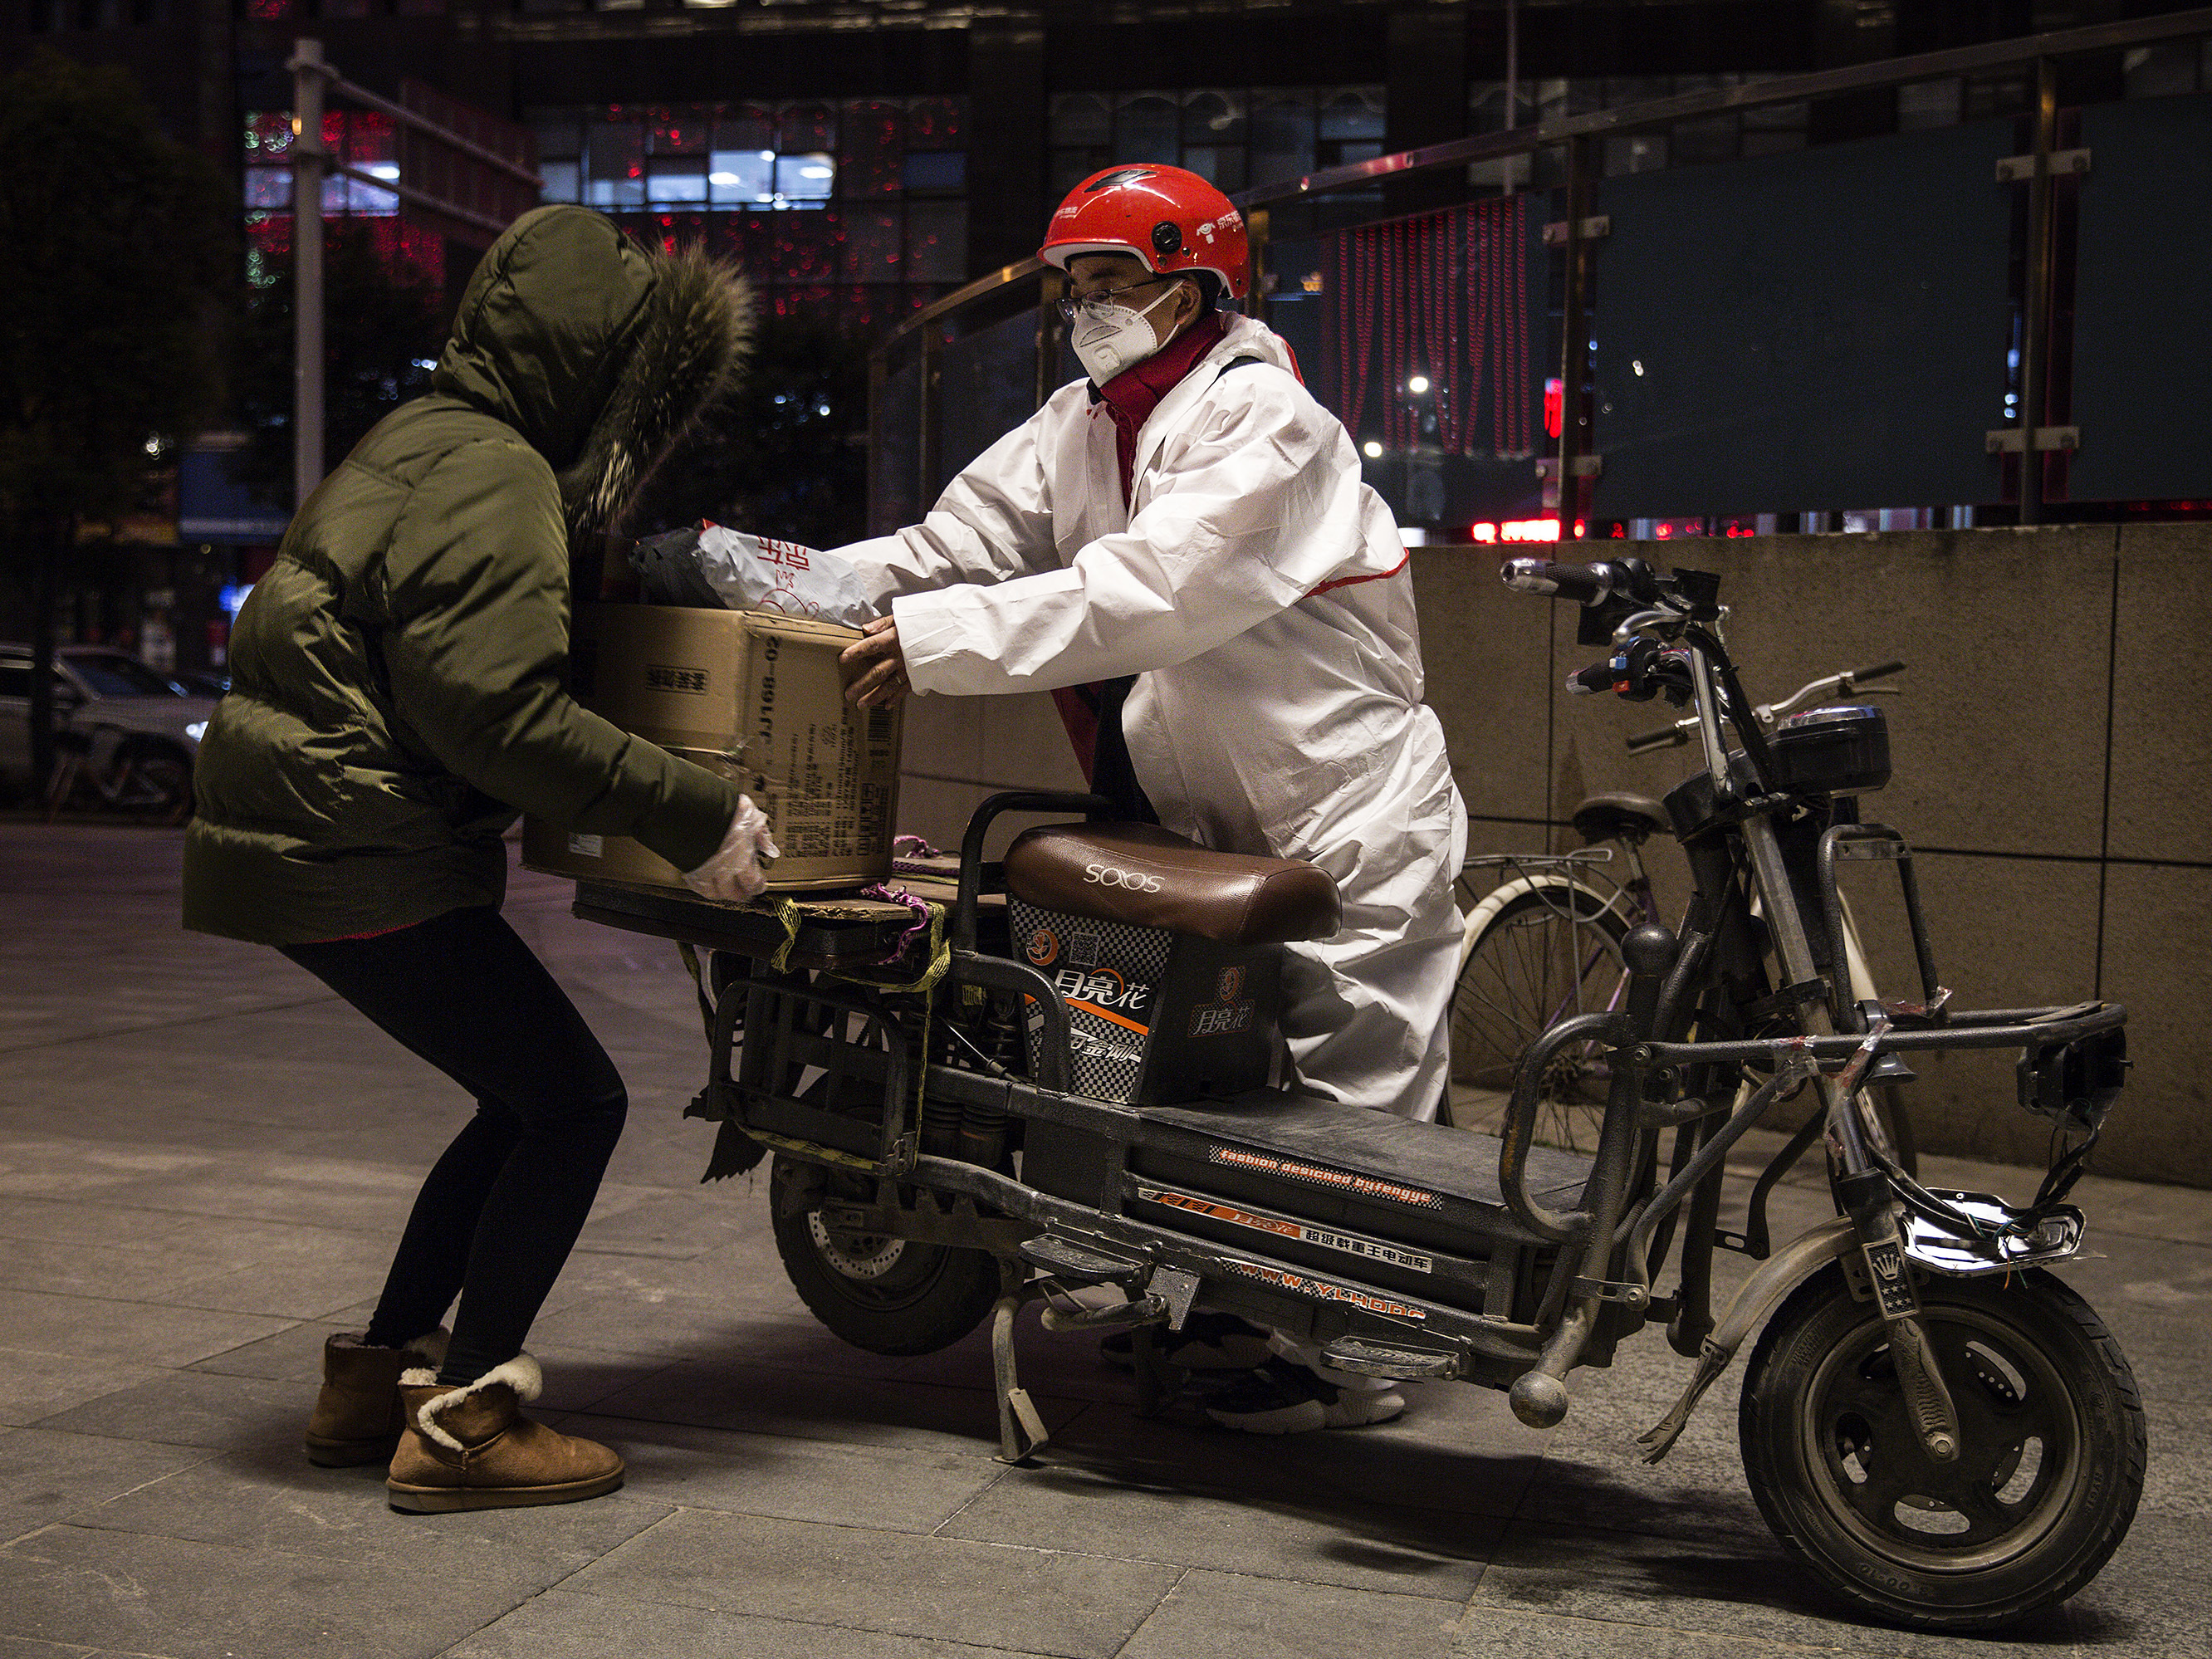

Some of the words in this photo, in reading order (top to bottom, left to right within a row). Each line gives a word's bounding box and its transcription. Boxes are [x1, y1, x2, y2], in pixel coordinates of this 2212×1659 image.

[756, 536, 810, 572] 京东
[1055, 968, 1150, 1010] 月亮花
[1192, 1006, 1250, 1035] 月亮花
[1305, 1228, 1430, 1270] 超级载重王电动车
